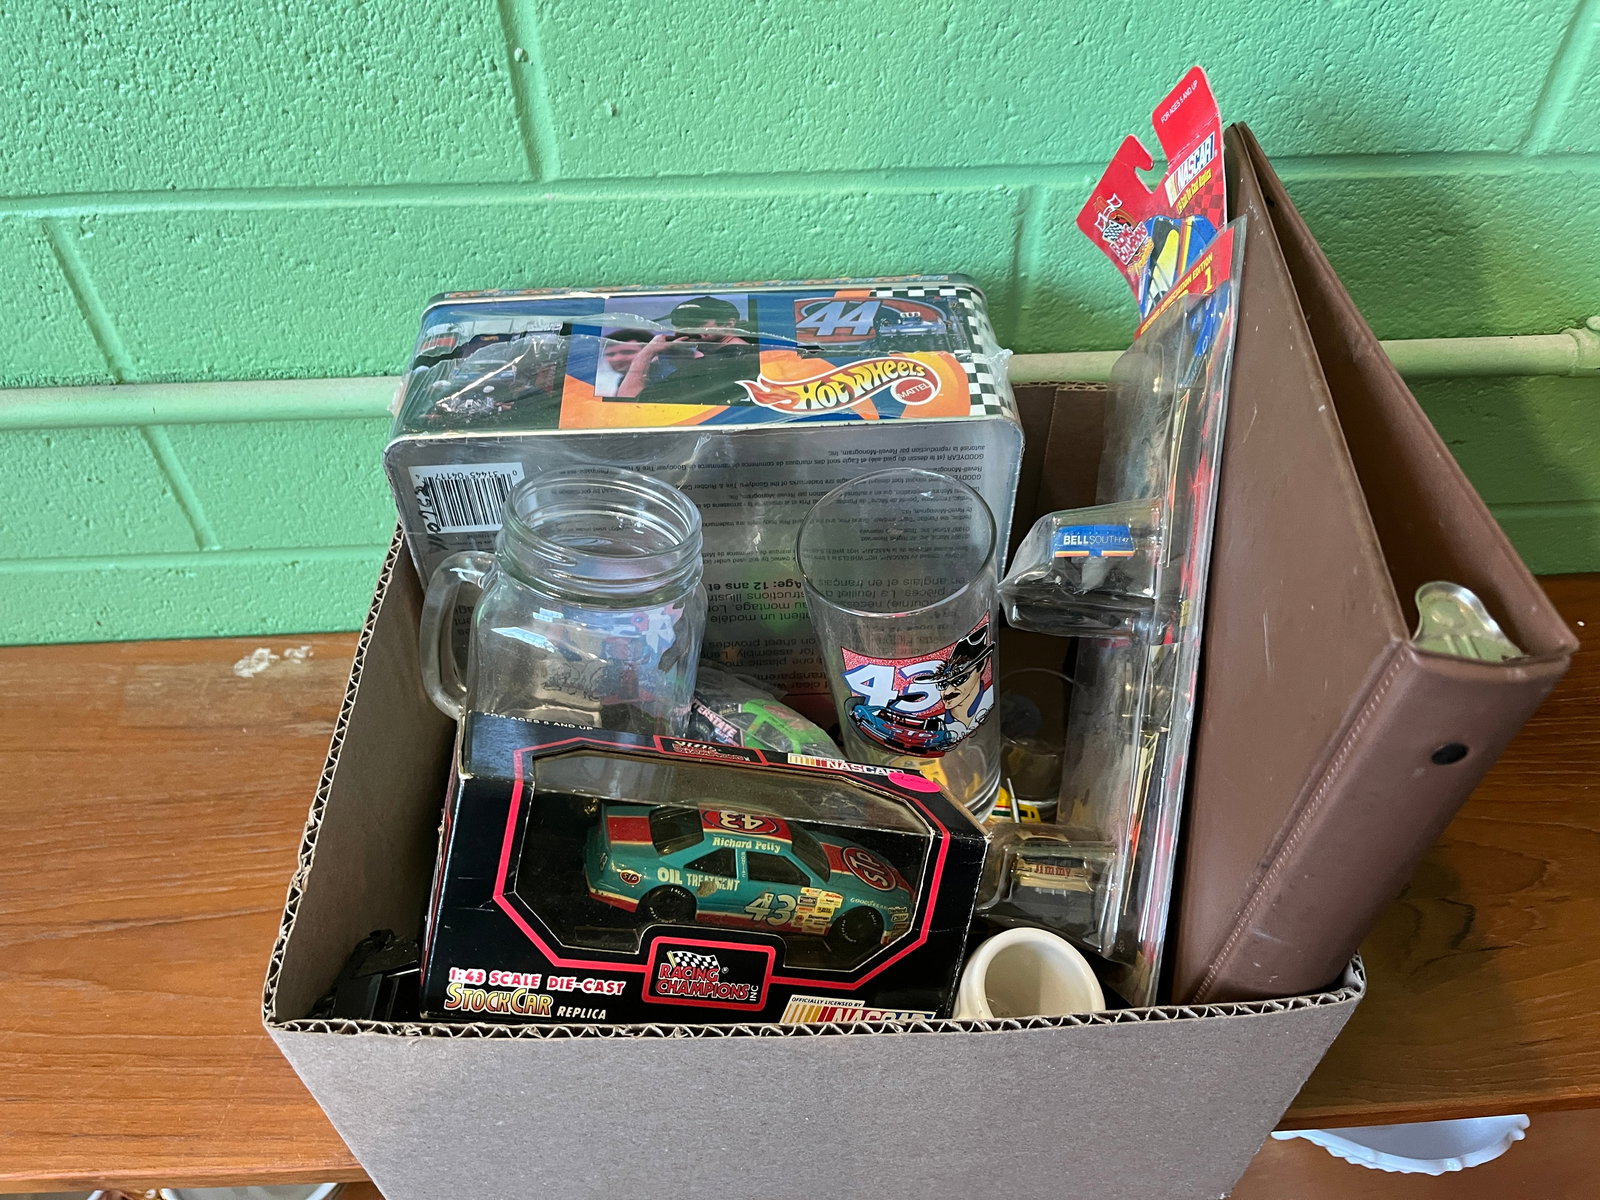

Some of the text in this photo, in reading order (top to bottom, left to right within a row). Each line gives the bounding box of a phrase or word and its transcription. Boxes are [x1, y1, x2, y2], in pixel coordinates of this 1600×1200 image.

[1169, 98, 1182, 114] AGES
[1175, 133, 1215, 193] NASCAR
[1192, 252, 1213, 280] EDITION
[797, 300, 881, 337] 44
[787, 359, 926, 411] HOT WHEELS
[899, 383, 932, 401] MATTEL
[911, 446, 952, 454] reproduction
[947, 453, 984, 461] GOODYEAR
[842, 457, 859, 465] Eagle
[469, 471, 498, 480] 31445
[708, 582, 722, 592] et
[725, 581, 750, 590] ans
[752, 581, 769, 590] 12
[772, 578, 802, 590] Age:
[866, 578, 883, 587] en
[902, 576, 947, 588] anglais
[731, 601, 790, 613] montage.
[709, 613, 757, 624] modèle
[720, 811, 764, 830] 43
[712, 837, 781, 853] Richard Petty
[622, 872, 639, 882] STP
[657, 867, 683, 885] OIL
[1034, 862, 1072, 878] Jimmy
[744, 892, 797, 926] 43
[659, 964, 720, 982] RACING
[449, 967, 627, 996] 1:43 SCALE DIE-CAST
[655, 980, 750, 1001] CHAMPIONS
[750, 985, 759, 1002] INC
[791, 997, 823, 1005] OFFICIALLY
[556, 1005, 608, 1021] REPLICA
